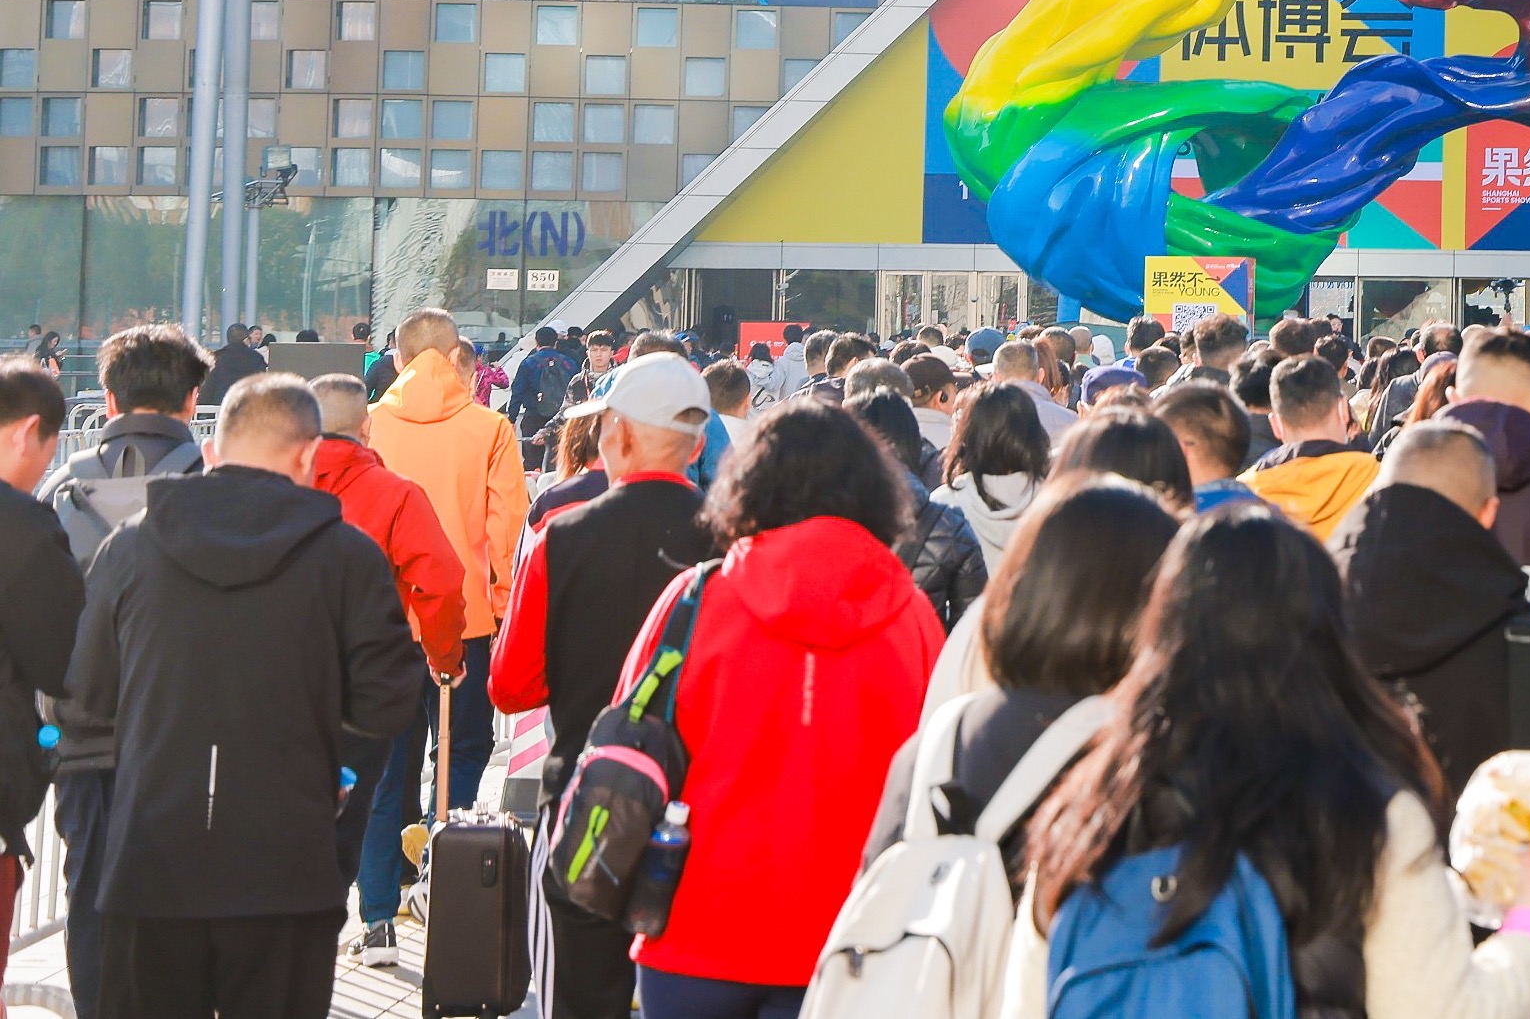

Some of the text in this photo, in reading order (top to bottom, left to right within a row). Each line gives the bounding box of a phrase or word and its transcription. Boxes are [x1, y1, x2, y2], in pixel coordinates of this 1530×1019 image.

[477, 211, 586, 257] 北(N)
[531, 272, 555, 282] 850
[1179, 285, 1221, 297] YOUNG
